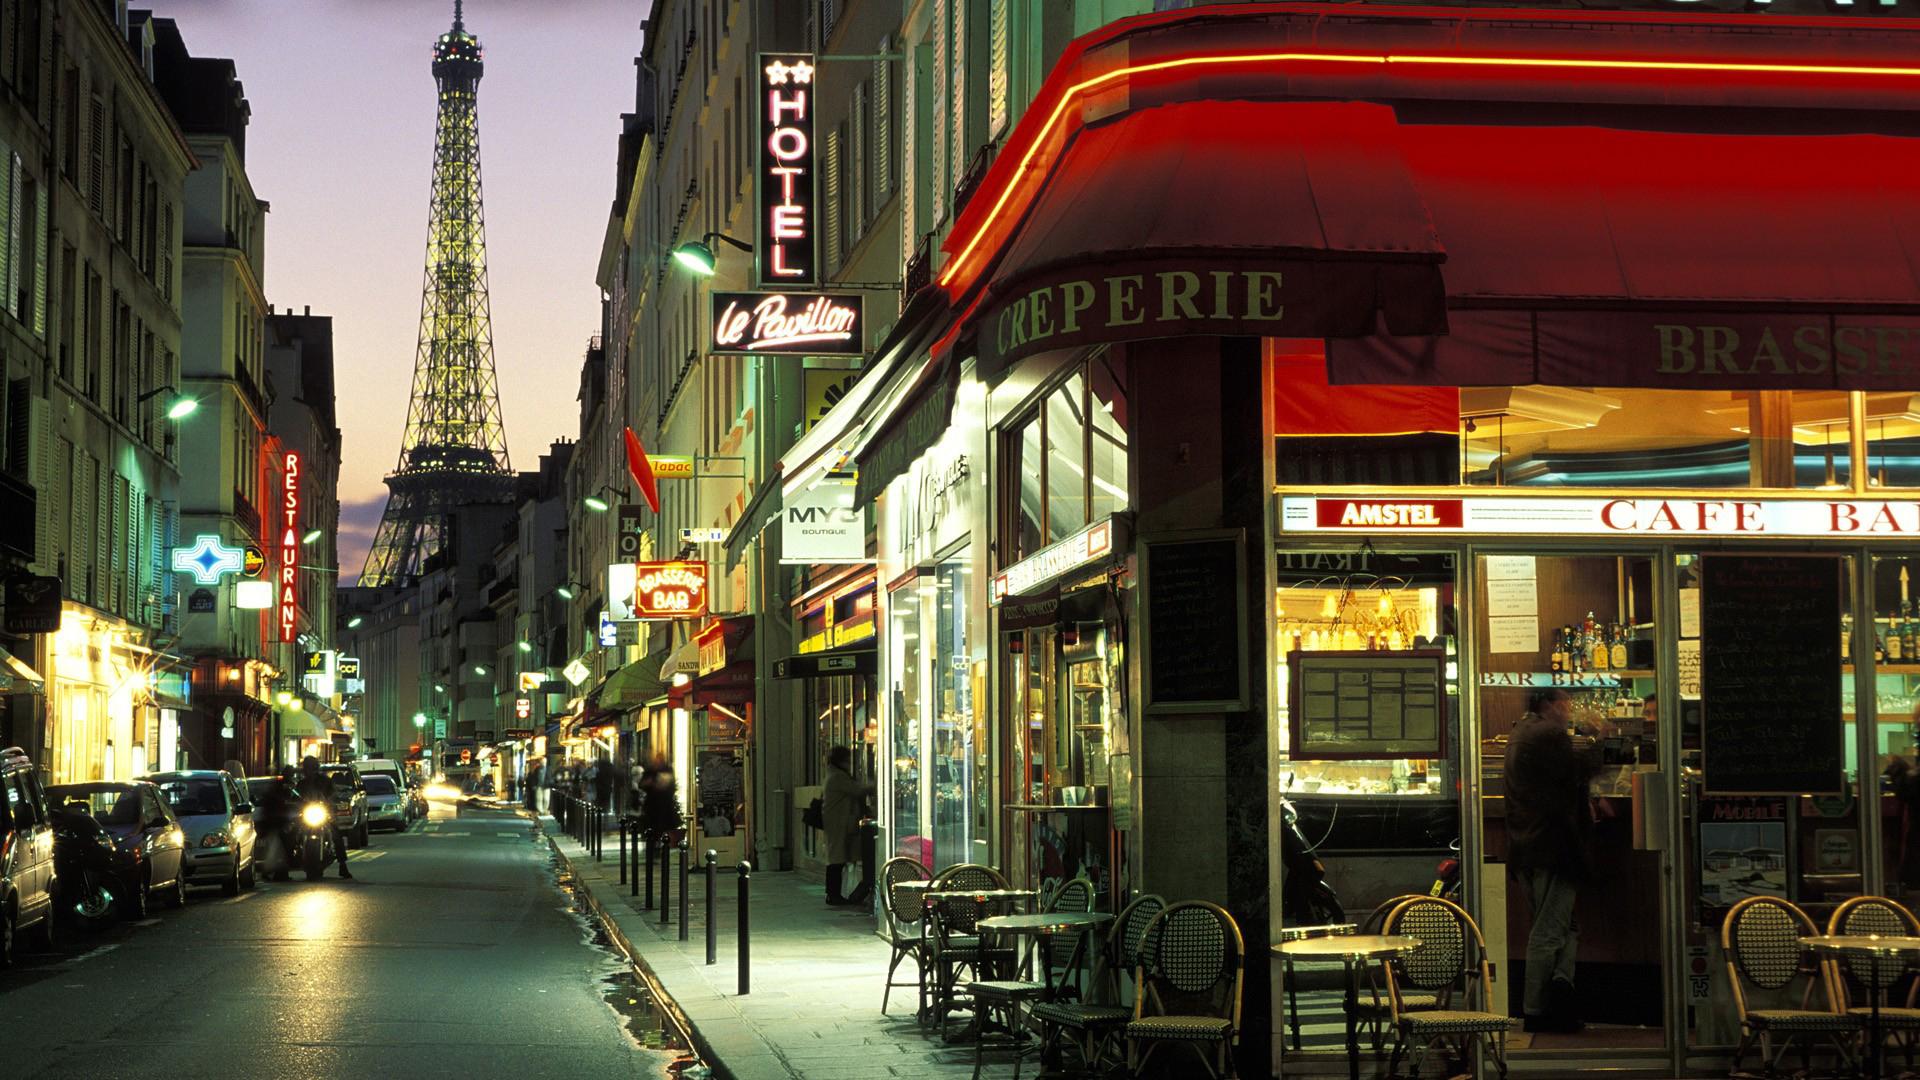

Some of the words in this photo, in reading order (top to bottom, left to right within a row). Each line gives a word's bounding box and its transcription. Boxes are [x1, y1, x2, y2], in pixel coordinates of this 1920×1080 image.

[769, 89, 807, 278] HOTEL
[752, 295, 855, 340] Pavillon
[996, 270, 1285, 355] CREPERIE
[1654, 324, 1920, 376] BRASSE
[1340, 503, 1441, 526] AMSTEL
[1600, 500, 1765, 531] CAFE
[1827, 502, 1920, 533] BA
[282, 454, 298, 640] RESTAURANT
[638, 569, 705, 595] BRASSERIE
[653, 591, 689, 610] BAR
[340, 665, 357, 673] CCF
[1480, 672, 1534, 686] BAR
[1712, 803, 1785, 820] MOBILE
